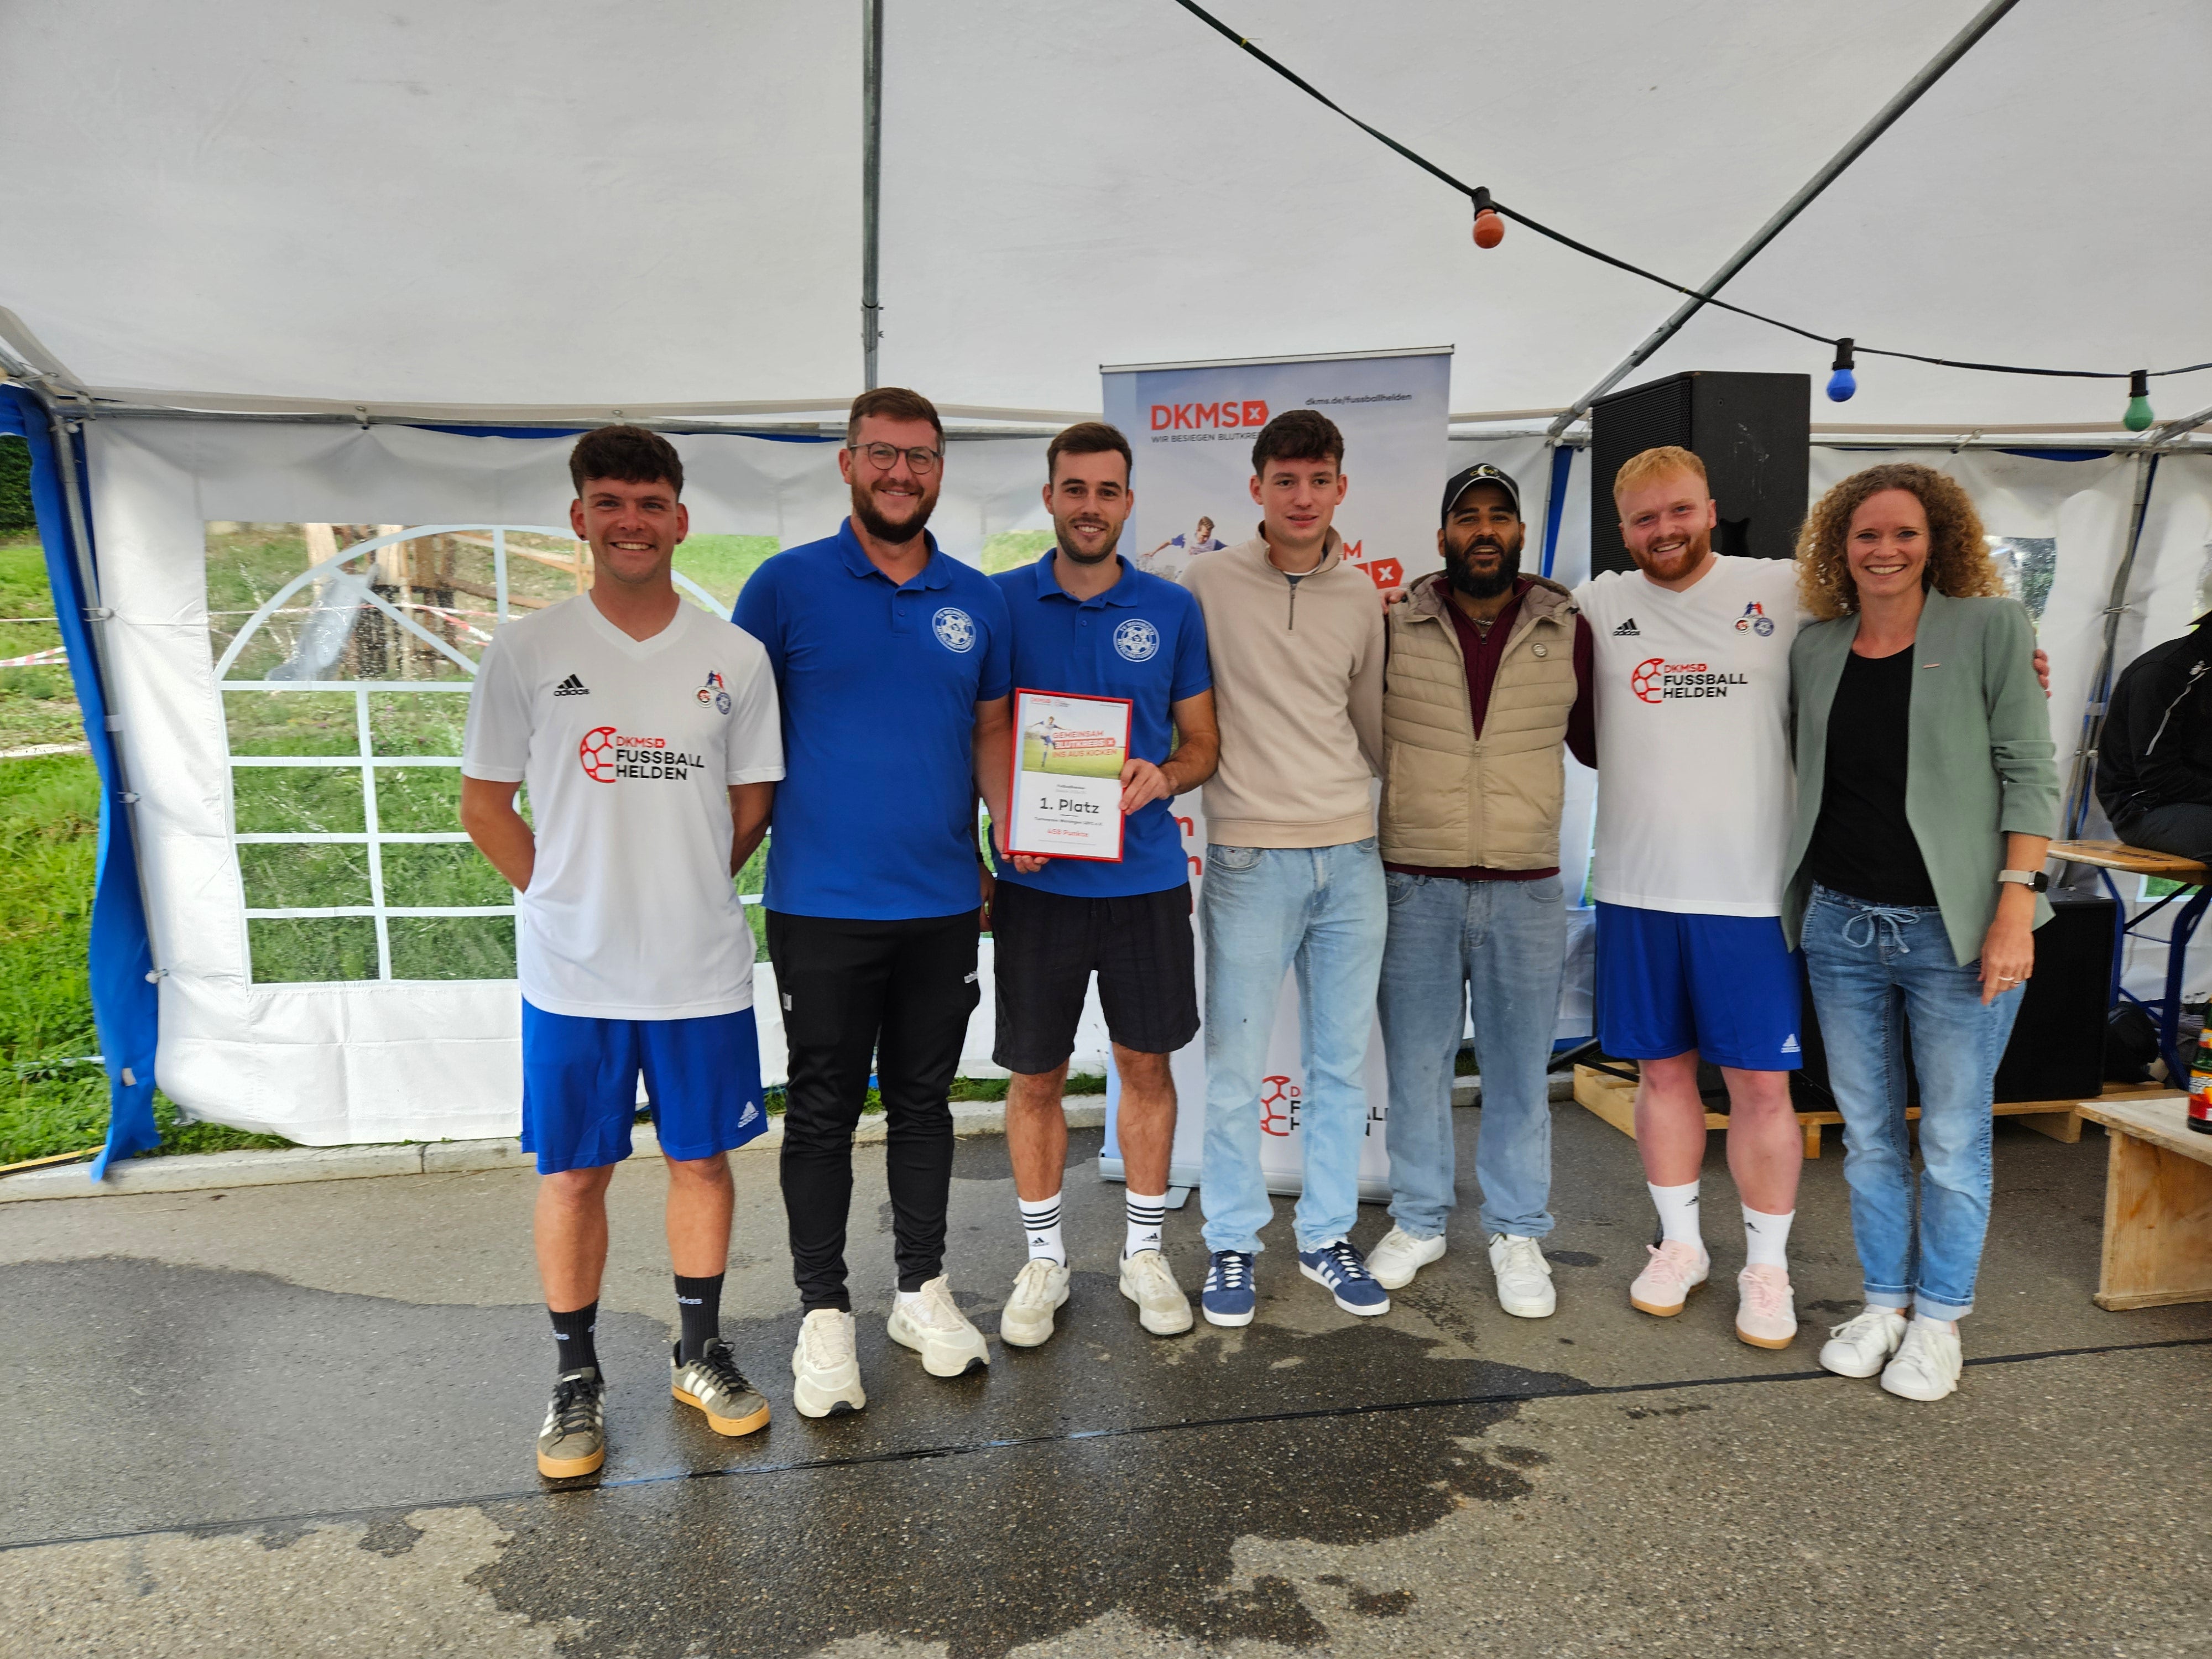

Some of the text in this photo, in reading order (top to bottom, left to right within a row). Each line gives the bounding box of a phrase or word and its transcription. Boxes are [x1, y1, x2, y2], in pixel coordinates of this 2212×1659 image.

[1305, 393, 1412, 405] dkms.de/fussballhelden
[1151, 401, 1240, 430] DKMS
[1171, 434, 1215, 442] BESIEGEN
[1218, 431, 1260, 441] BLUTKRE
[1663, 673, 1748, 686] FUSSBALL
[554, 688, 590, 697] adidas
[1663, 686, 1728, 698] HELDEN
[1052, 730, 1104, 739] GEMEINSAM
[616, 749, 705, 768] FUSSBALL
[1086, 748, 1117, 757] KICKEN
[616, 764, 687, 780] HELDEN
[1040, 797, 1100, 814] 1. Platz
